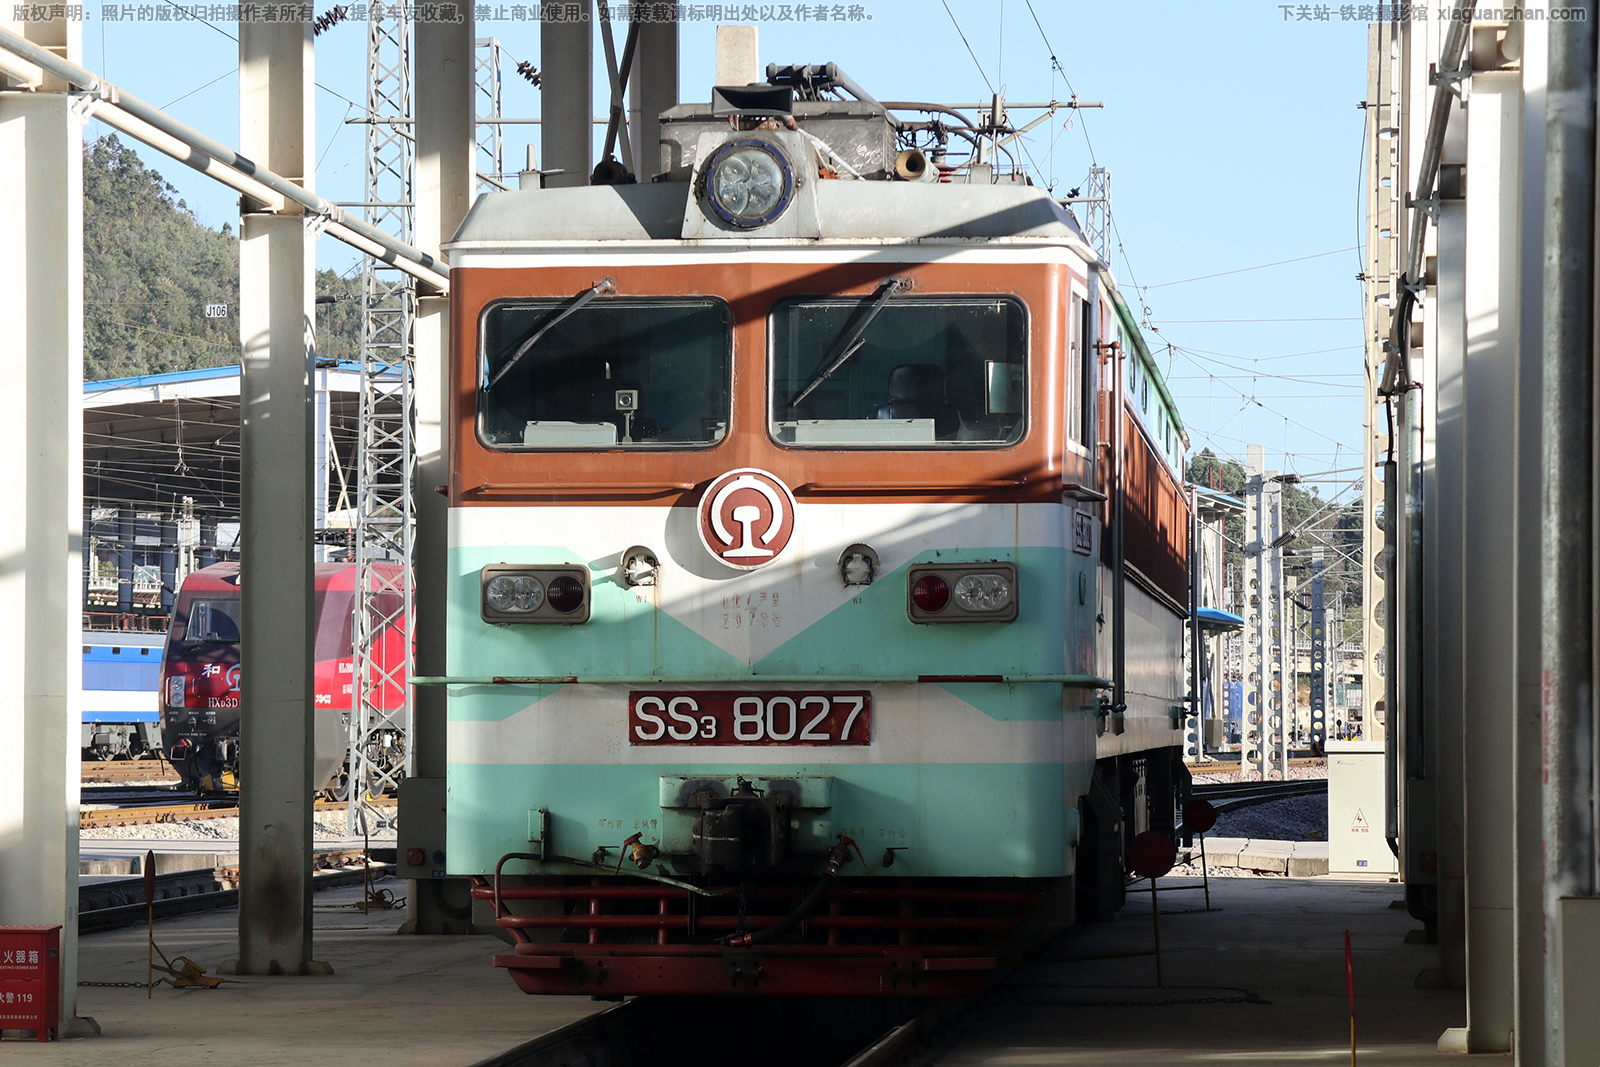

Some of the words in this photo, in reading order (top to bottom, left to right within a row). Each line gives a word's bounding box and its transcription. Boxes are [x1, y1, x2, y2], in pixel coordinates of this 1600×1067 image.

[979, 114, 1007, 128] J12
[206, 305, 226, 316] J106
[852, 597, 862, 605] W3
[201, 663, 221, 678] 和
[634, 696, 717, 741] SS3
[733, 696, 864, 741] 8027
[0, 949, 39, 964] 火器箱
[17, 993, 33, 1003] 119
